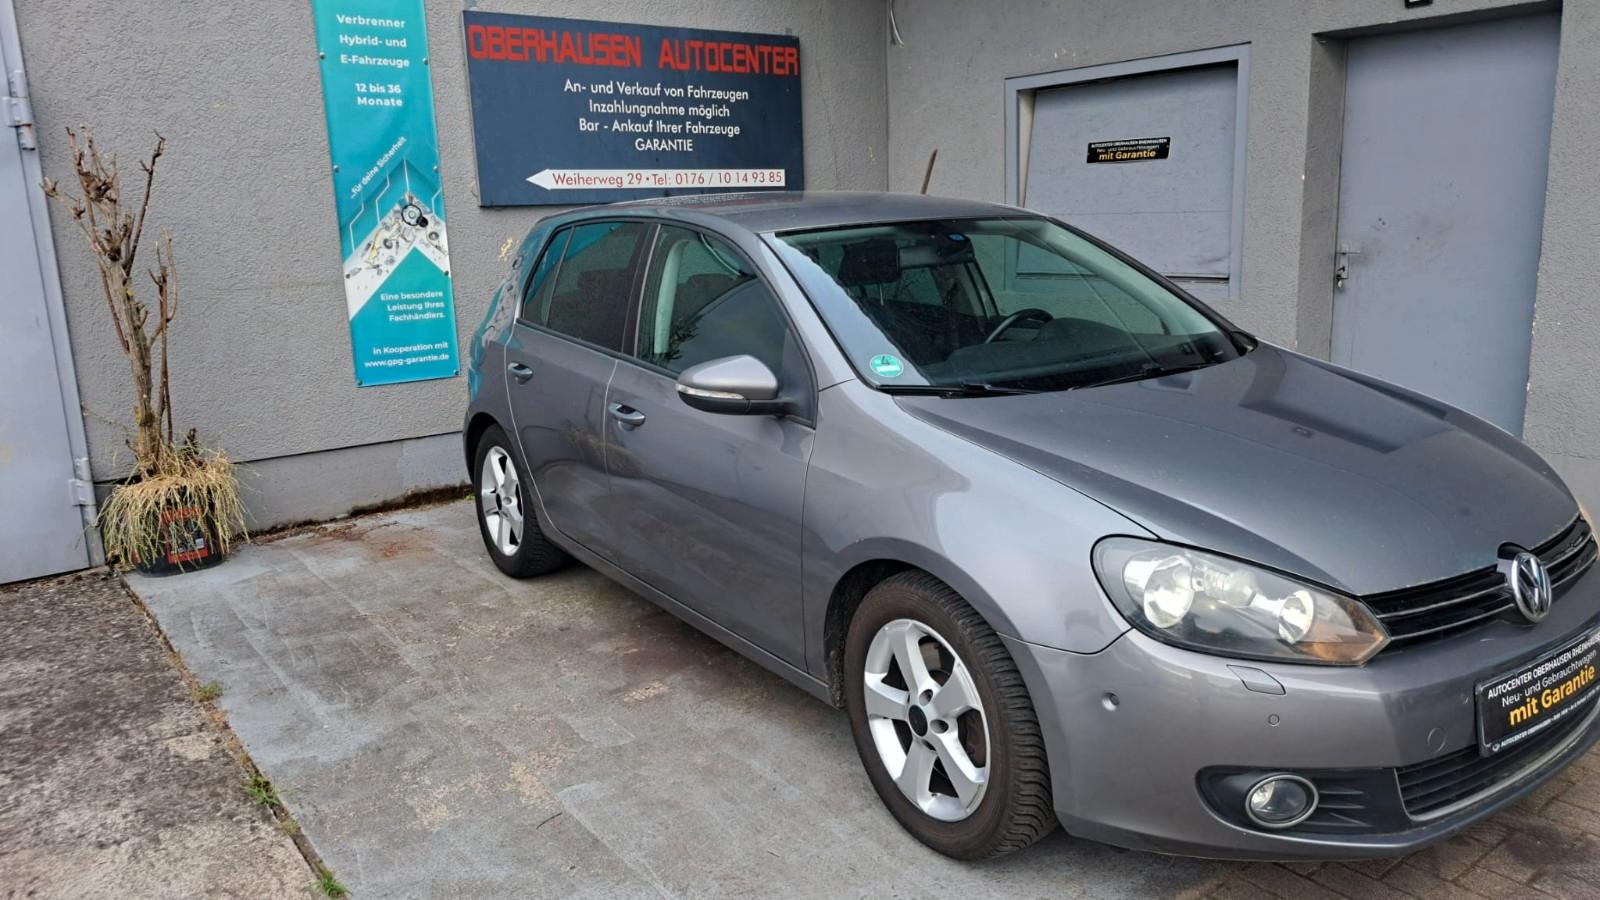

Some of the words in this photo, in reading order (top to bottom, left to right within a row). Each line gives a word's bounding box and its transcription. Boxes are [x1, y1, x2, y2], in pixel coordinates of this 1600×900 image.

[336, 14, 405, 28] Verbrenner
[339, 34, 382, 46] Hybrid-
[385, 38, 407, 48] und
[467, 24, 642, 69] OBERHAUSEN
[658, 38, 799, 76] AUTOCENTER
[340, 54, 410, 68] E-Fahrzeuge
[355, 83, 367, 93] 12
[369, 83, 385, 93] bis
[388, 84, 402, 94] 36
[564, 78, 586, 93] An-
[590, 80, 614, 94] und
[616, 81, 661, 97] Verkauf
[664, 87, 684, 97] von
[687, 85, 749, 103] Fahrzeugen
[357, 96, 404, 107] Monate
[589, 99, 685, 117] Inzahlungnahme
[689, 104, 730, 120] möglich
[579, 118, 600, 131] Bar
[612, 119, 654, 133] Ankauf
[656, 120, 682, 133] Ihrer
[686, 121, 740, 138] Fahrzeuge
[635, 138, 693, 152] GARANTIE
[1098, 152, 1114, 161] mit
[1115, 149, 1156, 160] Garantie
[362, 167, 379, 185] deine
[552, 172, 624, 188] Weiherweg
[627, 172, 643, 185] 29
[675, 172, 705, 185] 0176
[718, 172, 731, 184] 10
[736, 172, 748, 183] 14
[752, 171, 765, 183] 93
[768, 171, 782, 183] 85
[380, 293, 399, 301] Eine
[400, 291, 443, 300] besondere
[387, 303, 423, 312] Leistung
[424, 301, 445, 309] Ihres
[383, 343, 433, 354] Kooperation
[434, 341, 449, 350] mit
[364, 354, 449, 368] www.gpg-garantie.de
[1487, 671, 1533, 700] AUTOCENTER
[1532, 651, 1572, 678] OBERHAUSEN
[1502, 692, 1522, 708] Neu-
[1524, 679, 1541, 697] und
[1541, 649, 1597, 688] Gebrauchtwagen
[1510, 697, 1539, 726] mit
[1541, 664, 1595, 709] Garantie
